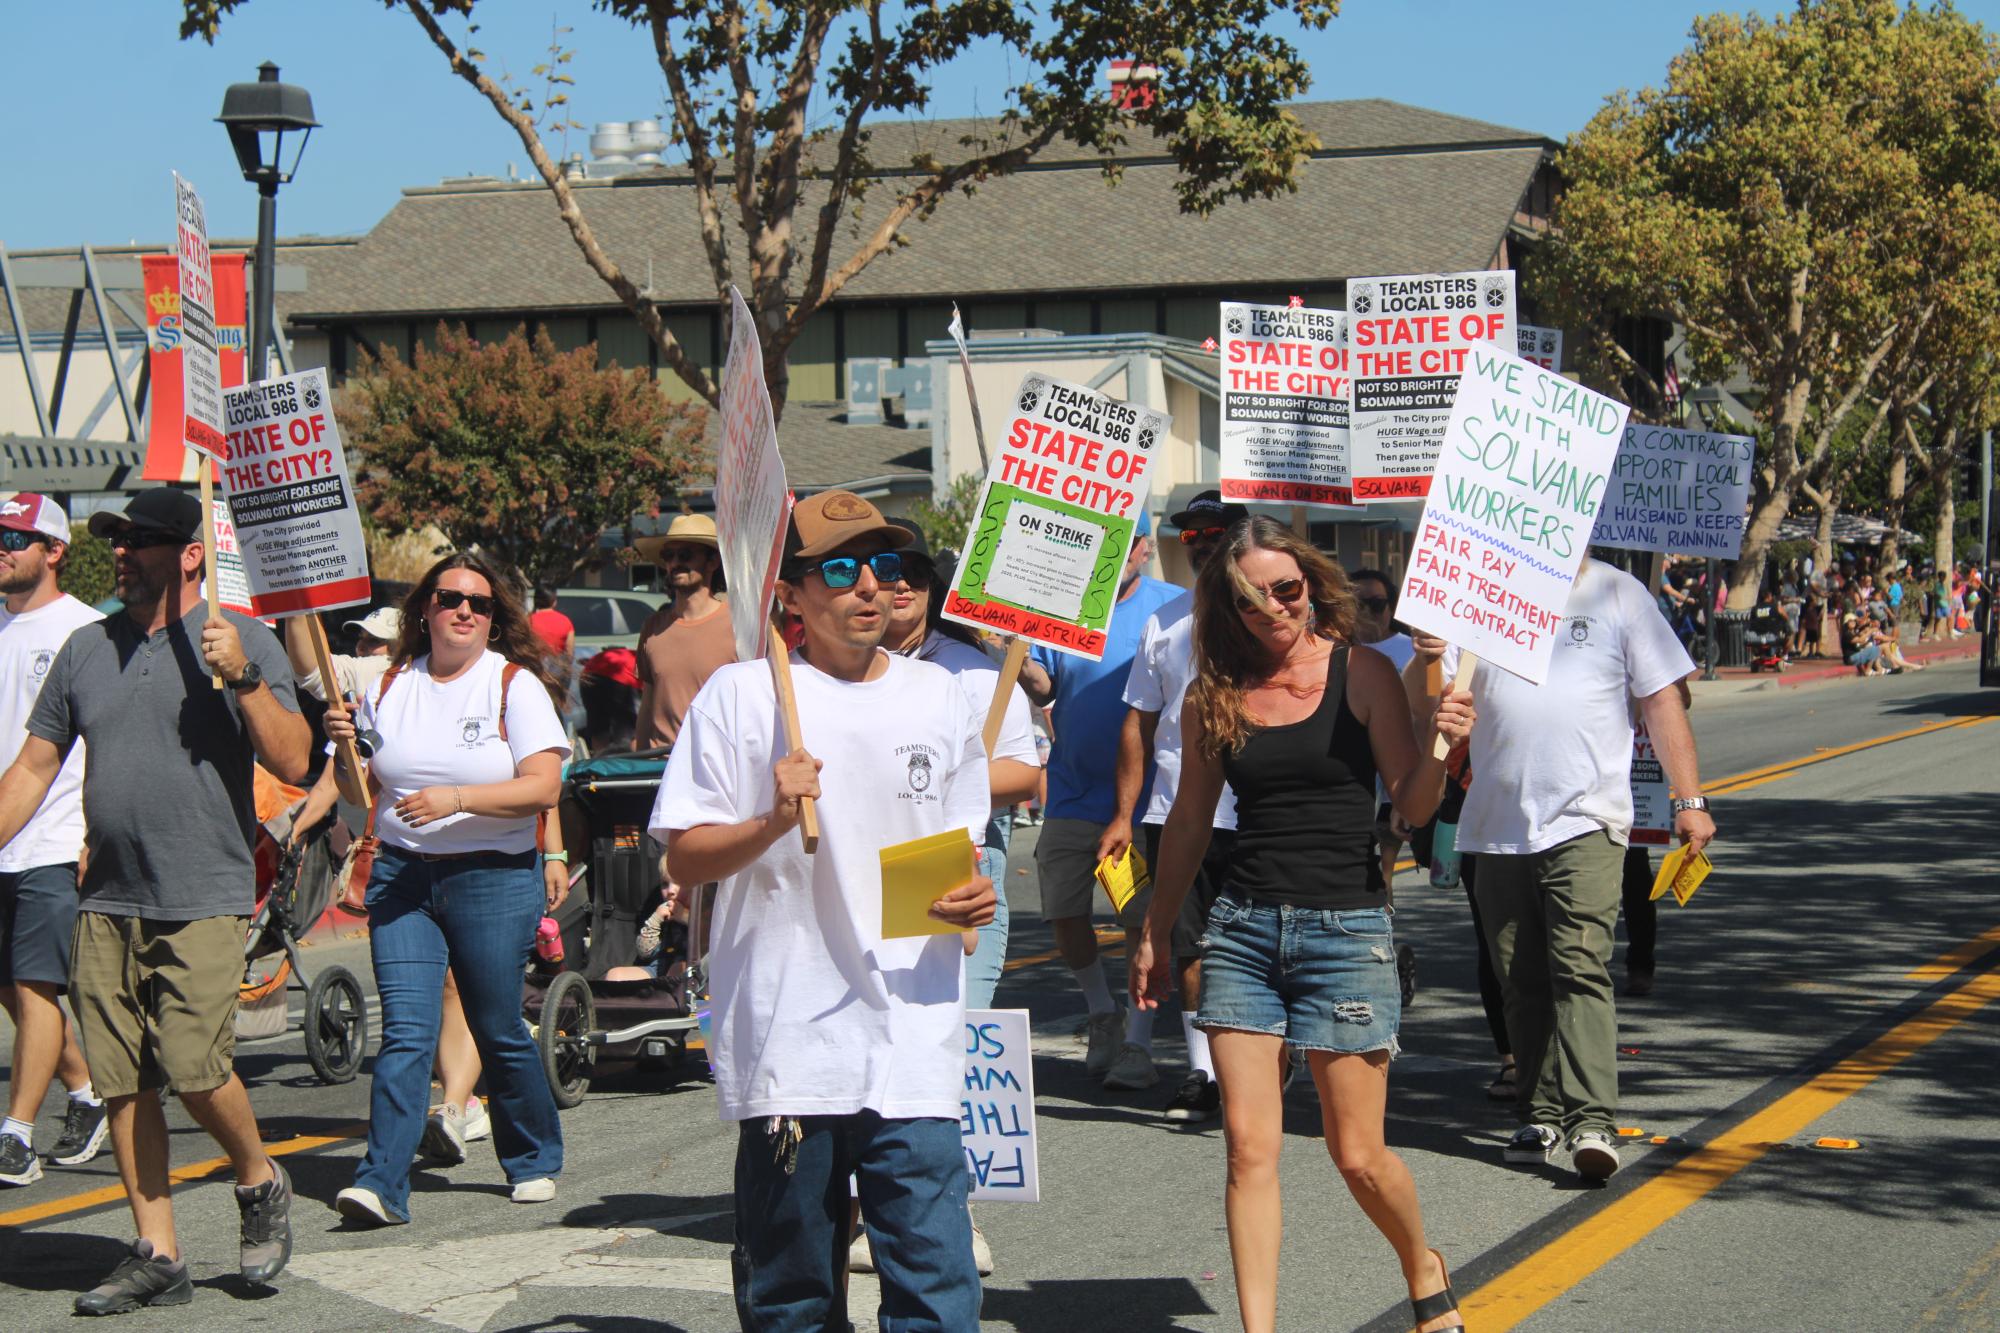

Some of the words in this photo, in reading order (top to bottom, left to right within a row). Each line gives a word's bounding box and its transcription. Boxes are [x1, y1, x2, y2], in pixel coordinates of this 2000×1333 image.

[1380, 279, 1476, 295] TEAMSTERS
[1381, 296, 1440, 312] LOCAL
[1445, 295, 1476, 309] 986
[1250, 309, 1334, 327] TEAMSTERS
[1356, 316, 1449, 346] STATE
[1460, 314, 1504, 341] OF
[1252, 323, 1304, 338] LOCAL
[1308, 328, 1334, 342] 986
[1229, 340, 1312, 367] STATE
[1357, 351, 1412, 375] THE
[1420, 349, 1469, 373] CIT
[1229, 369, 1279, 391] THE
[1358, 383, 1381, 393] NOT
[1383, 382, 1398, 391] SO
[1401, 380, 1442, 391] BRIGHT
[1445, 379, 1460, 390] FO
[224, 381, 295, 408] TEAMSTERS
[1050, 384, 1137, 425] TEAMSTERS
[1229, 396, 1249, 405] NOT
[1252, 397, 1266, 406] SO
[1269, 398, 1306, 408] BRIGHT
[1308, 401, 1326, 411] FOR
[1361, 396, 1413, 407] SOLVANG
[1416, 395, 1441, 405] CITY
[1476, 352, 1524, 395] WE
[1532, 374, 1619, 435] STAND
[228, 404, 270, 425] LOCAL
[272, 398, 298, 416] 986
[1044, 402, 1100, 434] LOCAL
[1103, 421, 1131, 443] 986
[1231, 408, 1280, 419] SOLVANG
[1282, 411, 1304, 420] CITY
[1307, 413, 1349, 425] WORKER
[1394, 415, 1409, 423] The
[1411, 415, 1429, 424] City
[226, 423, 284, 461] STATE
[289, 414, 325, 446] OF
[1278, 427, 1294, 437] City
[1297, 429, 1329, 439] provided
[1377, 428, 1403, 436] HUGE
[1405, 427, 1429, 436] Wage
[1492, 399, 1570, 452] WITH
[1008, 418, 1103, 472] STATE
[1106, 449, 1147, 484] OF
[1246, 437, 1270, 445] HUGE
[1273, 439, 1294, 447] Wage
[1296, 440, 1344, 451] adjustments
[1261, 449, 1286, 457] Senior
[1393, 440, 1421, 448] Senior
[1645, 430, 1751, 461] CONTRACTS
[1244, 459, 1264, 467] Then
[1266, 461, 1285, 469] gave
[1287, 461, 1308, 469] them
[1310, 463, 1347, 473] ANOTHER
[1376, 453, 1397, 461] Then
[1400, 454, 1420, 462] gave
[1382, 465, 1421, 473] Increase
[1456, 416, 1605, 517] SOLVANG
[225, 463, 264, 491] THE
[266, 449, 332, 484] CITY?
[1614, 454, 1688, 480] PPORT
[1696, 464, 1743, 486] LOCAL
[232, 499, 247, 510] NOT
[249, 496, 259, 506] SO
[261, 490, 289, 503] BRIGHT
[291, 485, 310, 498] FOR
[312, 479, 340, 494] SOME
[1000, 453, 1058, 495] THE
[1061, 474, 1134, 517] CITY?
[1226, 481, 1290, 499] SOLVANG
[1358, 479, 1421, 496] SOLVANG
[237, 508, 272, 523] SOLVANG
[273, 505, 291, 517] CITY
[291, 495, 341, 513] WORKERS
[1623, 483, 1721, 512] FAMILIES
[263, 529, 273, 537] The
[275, 526, 287, 536] City
[288, 520, 320, 534] provided
[1446, 474, 1574, 559] WORKERS
[1615, 506, 1687, 525] HUSBAND
[1696, 515, 1742, 530] KEEPS
[256, 542, 272, 552] HUGE
[274, 539, 289, 551] Wage
[291, 531, 338, 547] adjustments
[1019, 514, 1041, 530] ON
[1044, 523, 1093, 547] STRIKE
[1593, 523, 1657, 544] SOLVANG
[1668, 530, 1728, 548] RUNNING
[268, 552, 287, 563] Senior
[1424, 524, 1471, 561] FAIR
[1482, 550, 1515, 578] PAY
[261, 568, 275, 577] Then
[276, 567, 289, 577] gave
[290, 562, 307, 572] them
[308, 555, 347, 569] ANOTHER
[269, 579, 293, 589] Increase
[302, 576, 315, 586] top
[316, 573, 324, 582] of
[326, 569, 344, 579] that!
[1416, 549, 1461, 584] FAIR
[1467, 572, 1561, 635] TREATMENT
[953, 597, 1017, 628] SOLVANG
[1023, 620, 1040, 633] ON
[1043, 623, 1100, 650] STRIKE
[1407, 577, 1447, 609] FAIR
[1452, 599, 1539, 650] CONTRACT
[894, 744, 940, 760] TEAMSTERS
